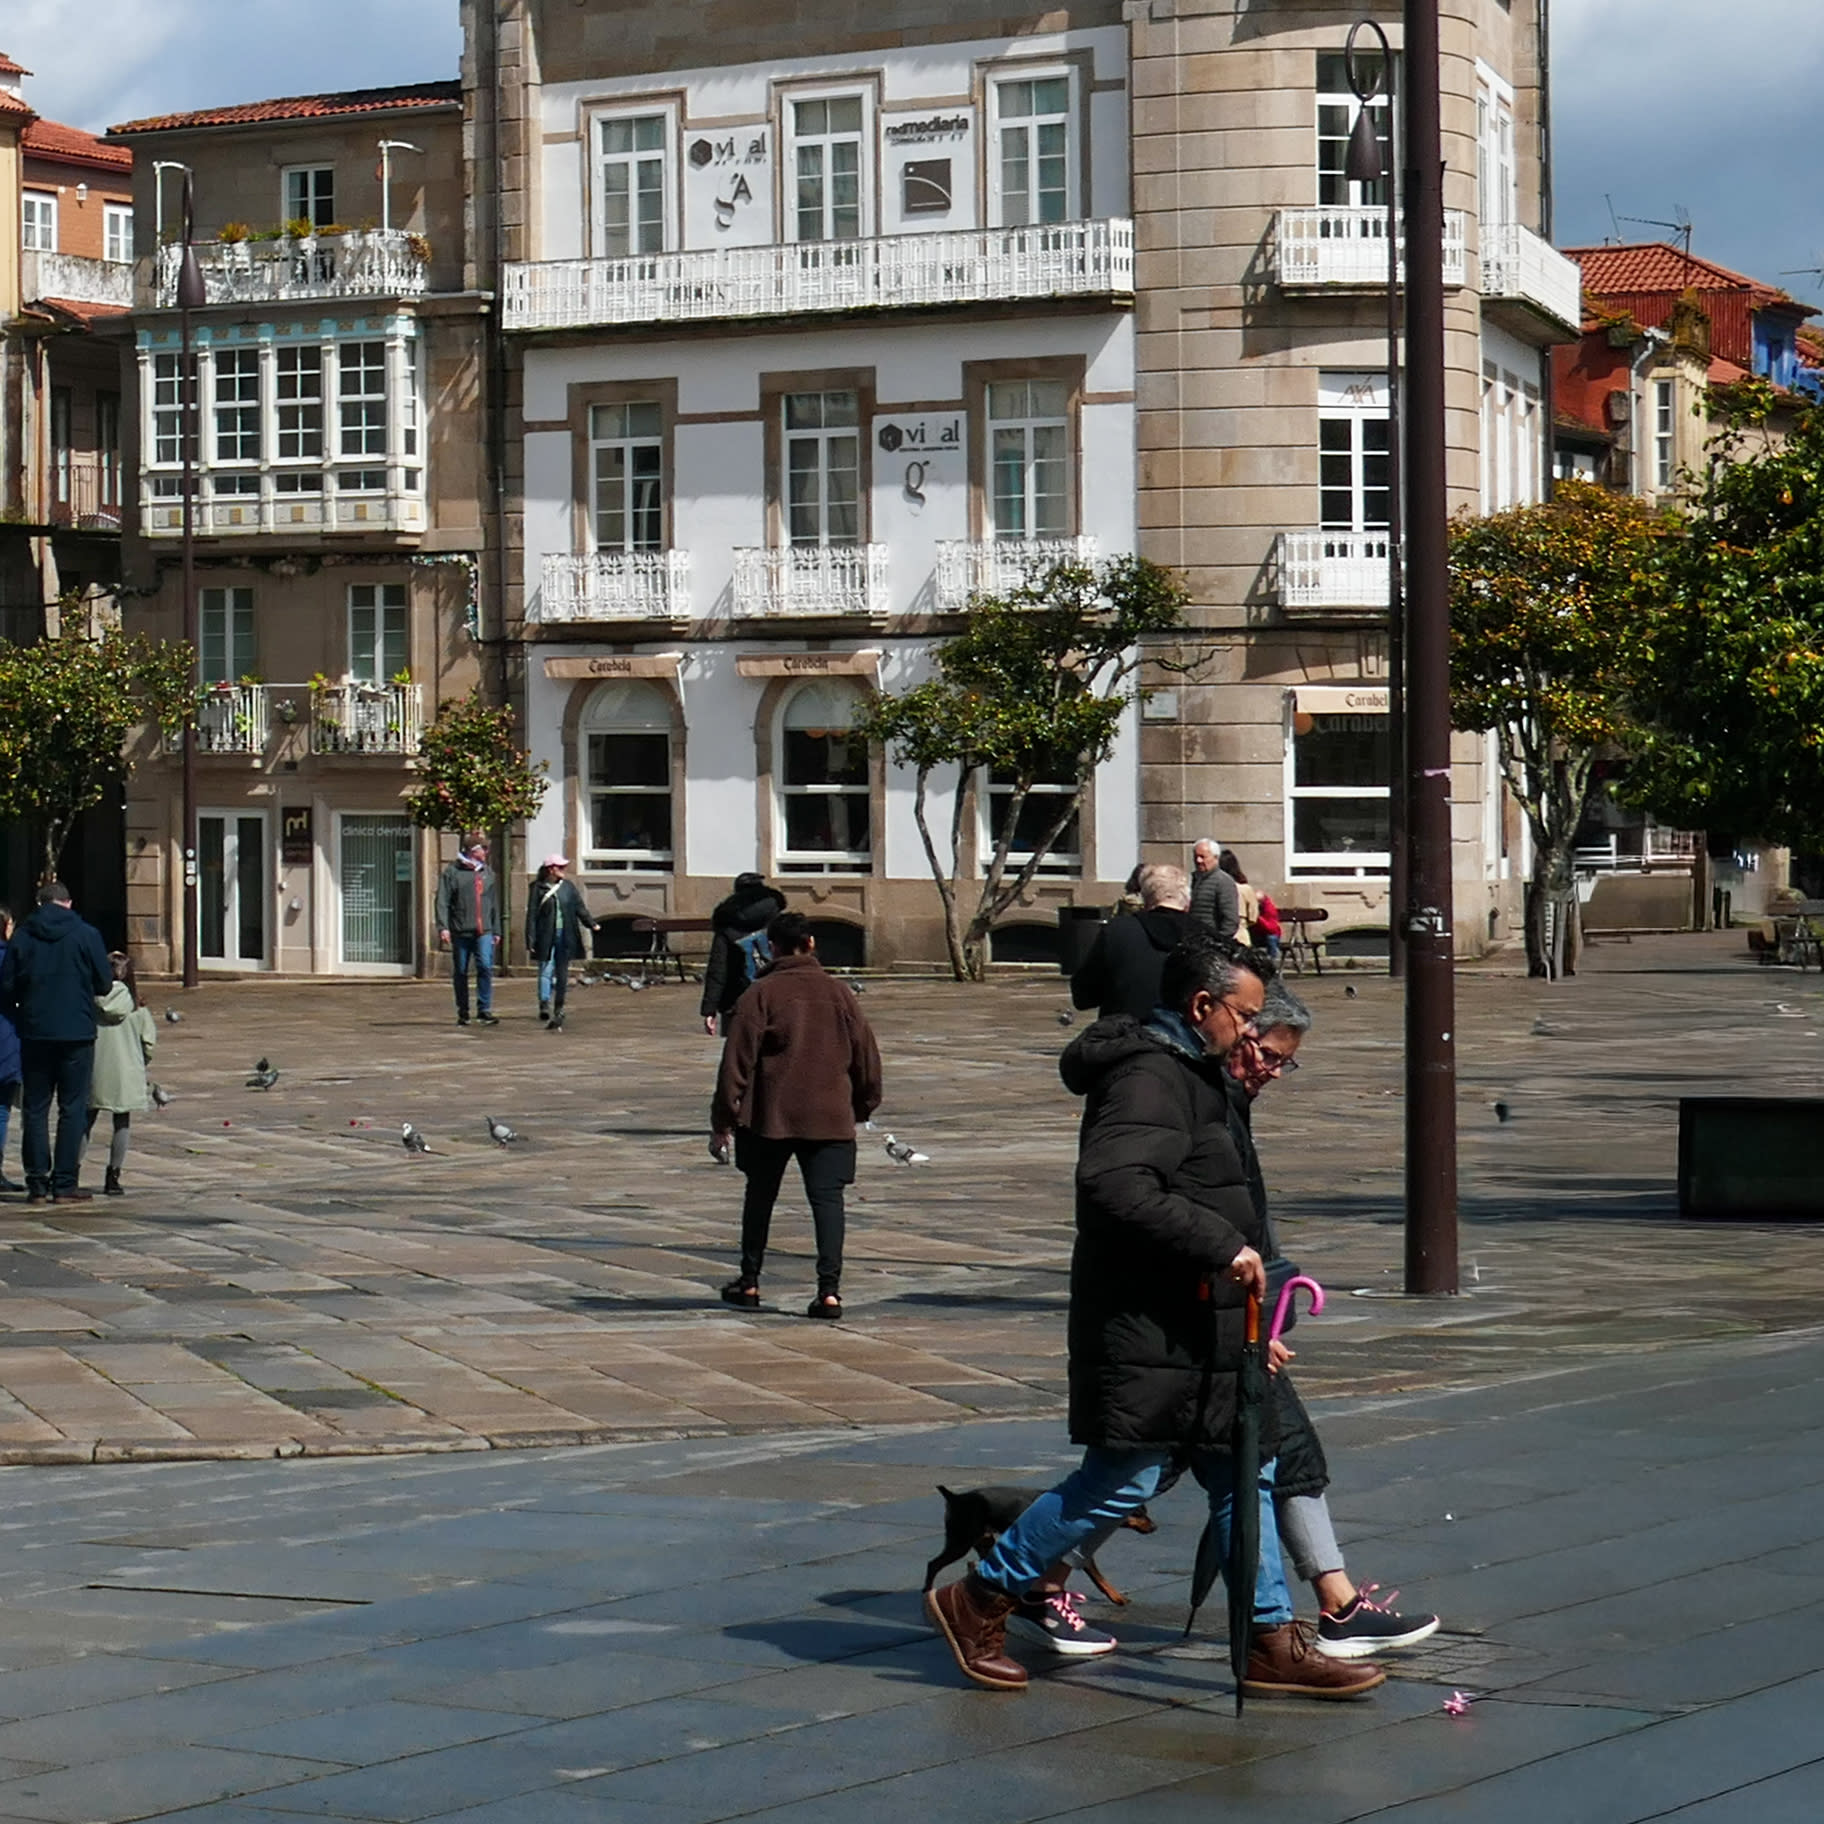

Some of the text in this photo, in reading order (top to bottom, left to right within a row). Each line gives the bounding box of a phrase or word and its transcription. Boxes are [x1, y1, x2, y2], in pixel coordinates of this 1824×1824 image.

[714, 131, 766, 157] vial
[905, 419, 960, 443] vial
[1345, 693, 1388, 707] Carabel
[1316, 716, 1389, 733] Carabel
